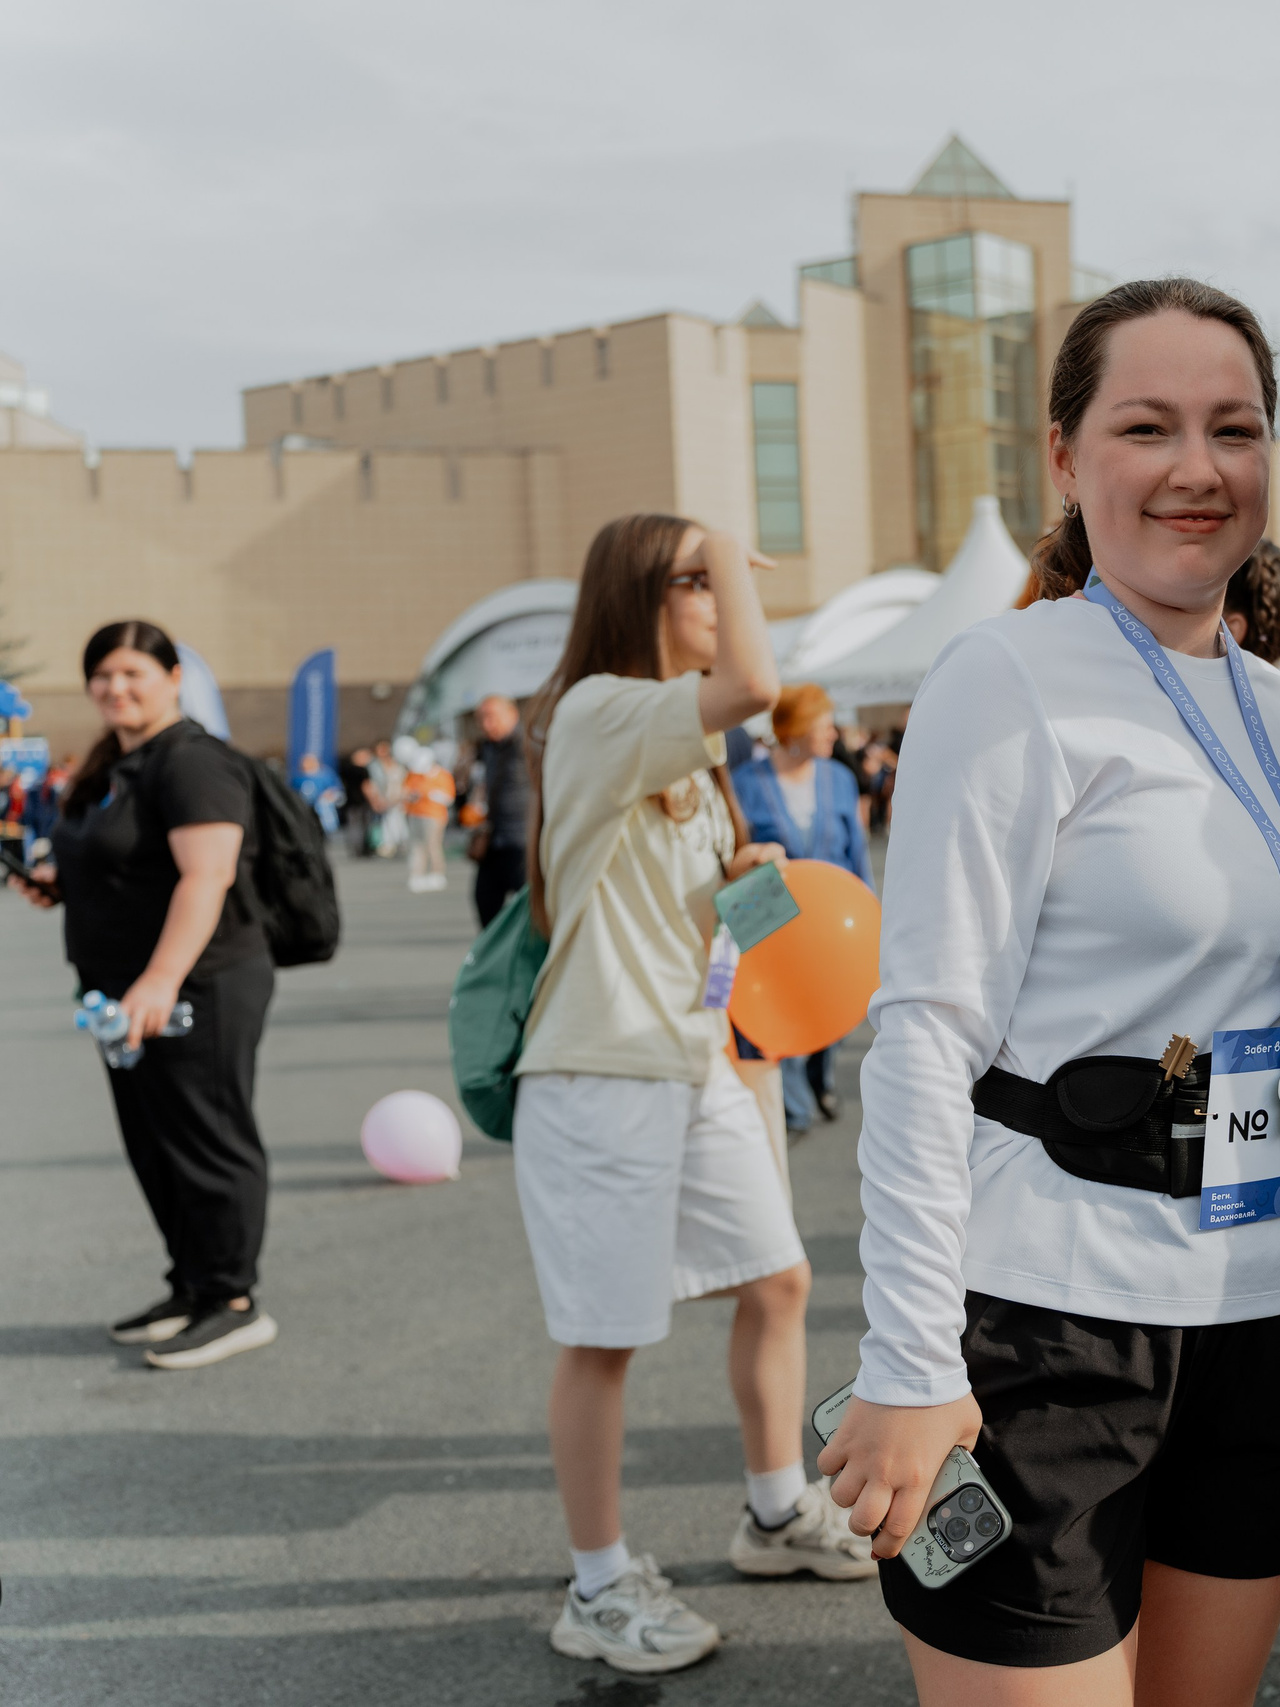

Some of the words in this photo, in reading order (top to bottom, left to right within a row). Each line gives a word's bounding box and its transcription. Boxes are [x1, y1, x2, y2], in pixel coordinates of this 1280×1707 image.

[1235, 662, 1253, 709] Урала
[1111, 602, 1150, 646] Забег
[1148, 650, 1213, 741] волонтёров
[1213, 746, 1259, 813] Южного
[1250, 715, 1279, 779] Южного
[1244, 1045, 1272, 1055] Забег
[1211, 1192, 1232, 1201] Беги.
[1210, 1200, 1246, 1212] Помогай.
[1210, 1209, 1257, 1223] Вдохновляй.
